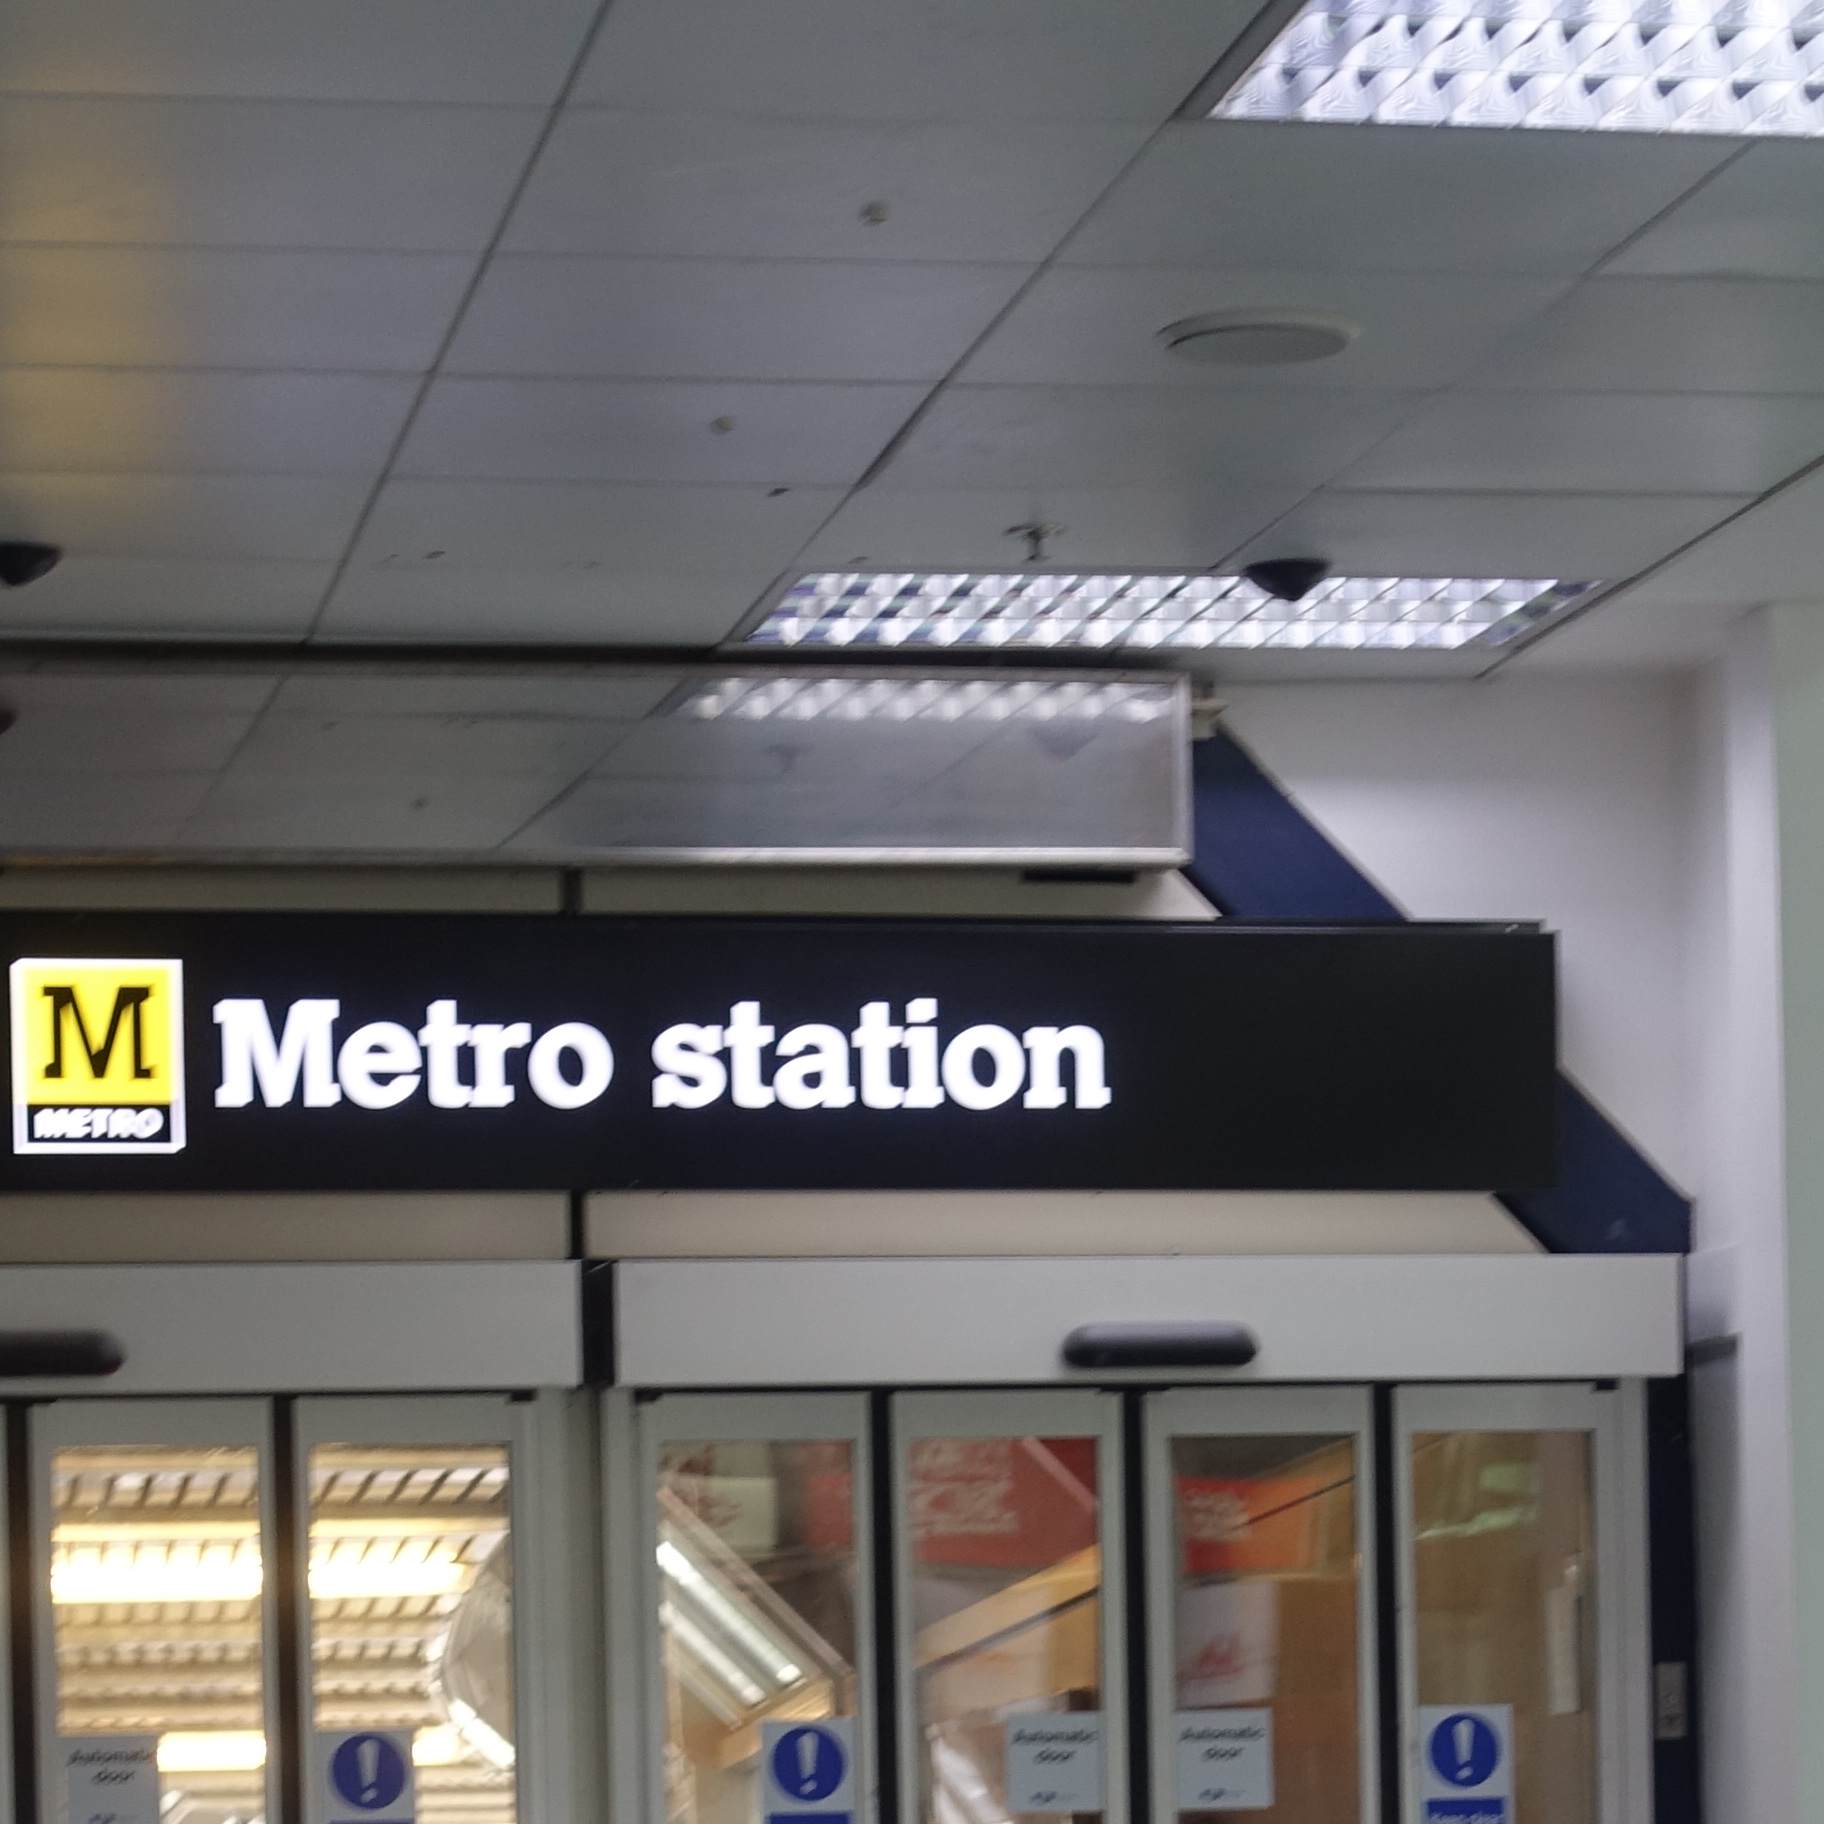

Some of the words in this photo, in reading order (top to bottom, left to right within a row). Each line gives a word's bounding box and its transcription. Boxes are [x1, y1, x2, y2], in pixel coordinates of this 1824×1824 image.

[41, 986, 154, 1079] M
[212, 998, 613, 1109] Metro
[651, 997, 1111, 1110] station
[33, 1107, 164, 1139] METRO
